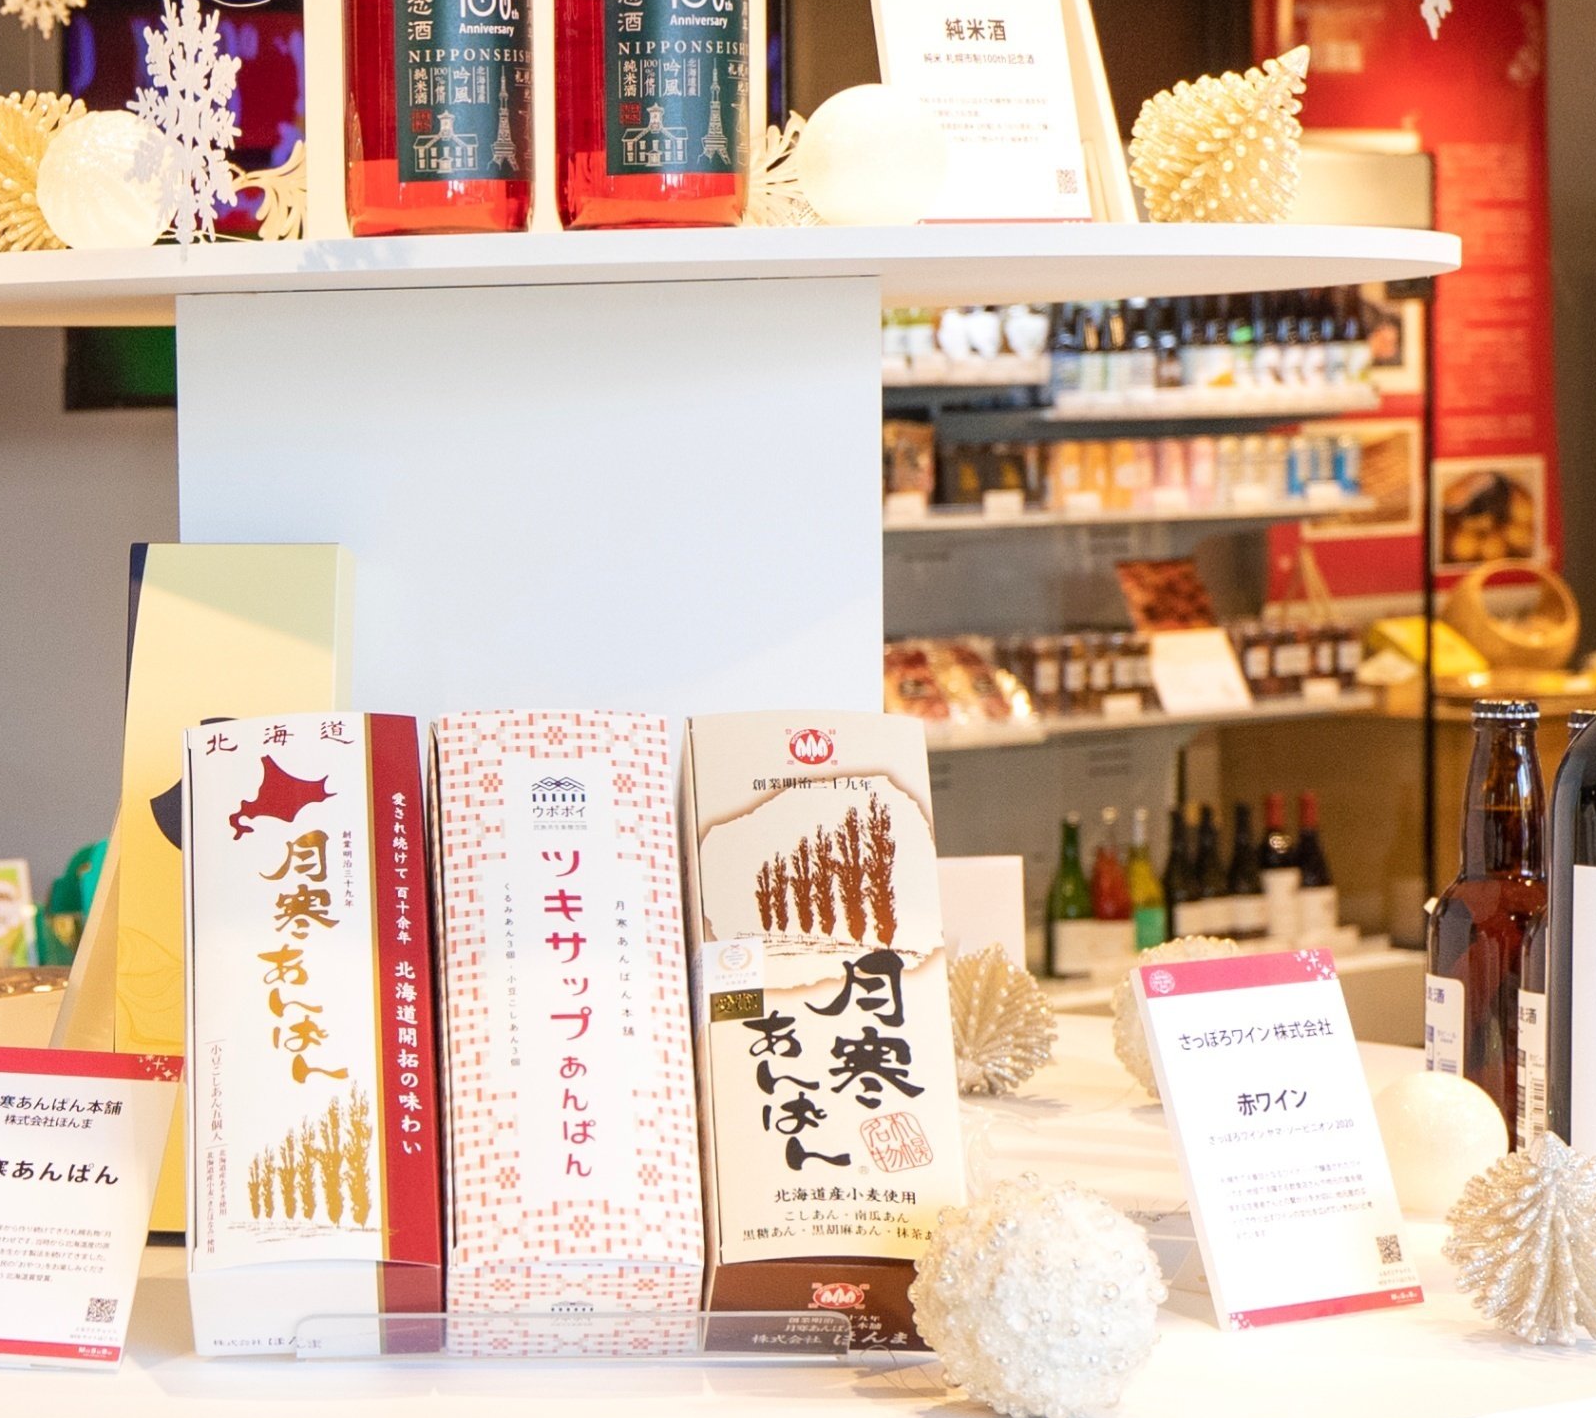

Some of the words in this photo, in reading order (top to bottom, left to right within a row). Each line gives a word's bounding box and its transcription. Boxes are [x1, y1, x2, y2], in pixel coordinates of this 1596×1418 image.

[459, 22, 514, 37] Anniversary
[670, 14, 728, 29] Anniversary
[945, 18, 1007, 41] 純米酒
[413, 67, 428, 105] 純米酒
[452, 66, 472, 103] 吟風
[622, 59, 638, 97] 純米酒
[662, 58, 682, 97] 吟風
[206, 720, 354, 756] 北海道
[753, 776, 872, 792] 創業明治三十九年
[532, 805, 586, 819] ウポポイ
[391, 791, 410, 880] 愛され続けて
[394, 886, 412, 946] 百十余年
[258, 829, 350, 1084] 月寒あんぱん
[615, 900, 635, 1037] 月寒あんぱん本舗
[804, 949, 925, 1109] 月寒
[1273, 1016, 1334, 1041] 株式会社
[394, 961, 422, 1155] 北海道開拓の味わい
[742, 1009, 851, 1171] あんぱん
[1237, 1089, 1308, 1116] 赤ワイン
[5, 1114, 93, 1129] 株式会社ほんま
[774, 1187, 916, 1205] 北海道産小麦使用
